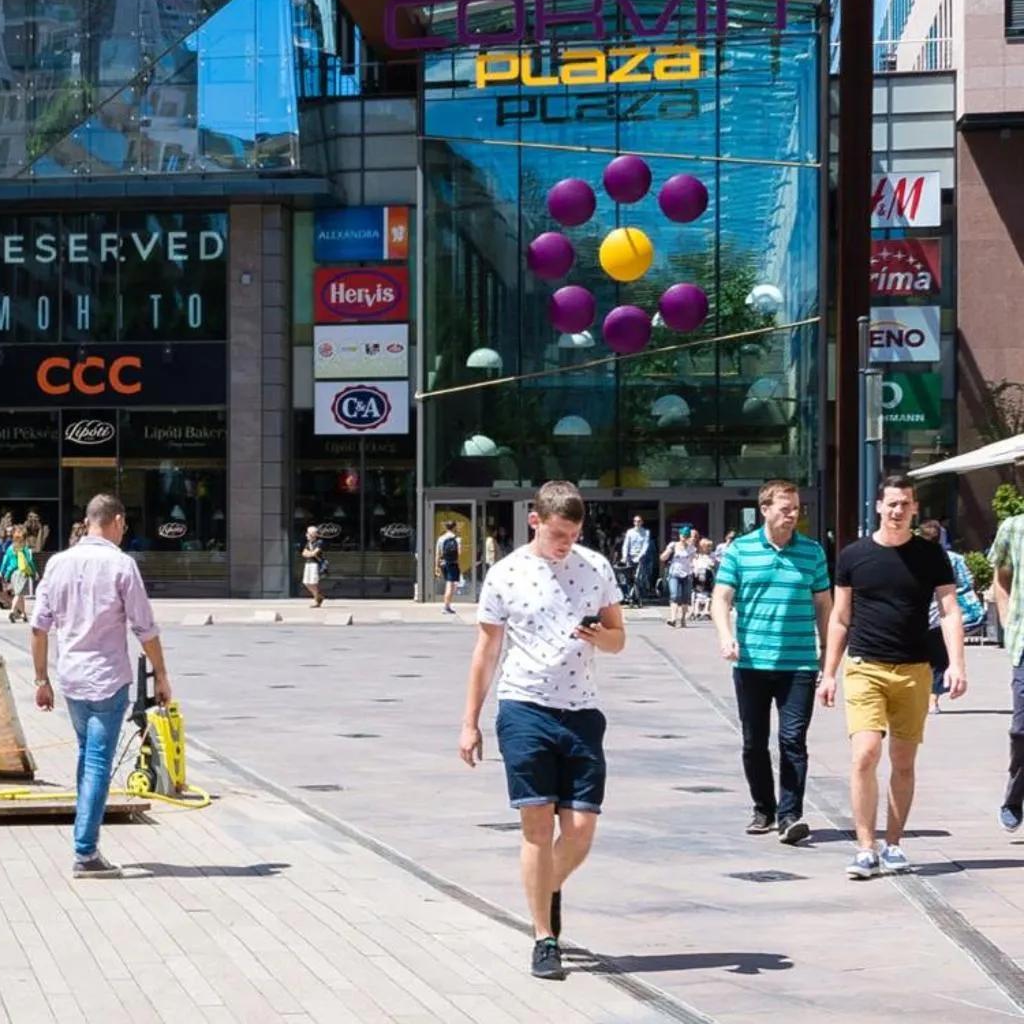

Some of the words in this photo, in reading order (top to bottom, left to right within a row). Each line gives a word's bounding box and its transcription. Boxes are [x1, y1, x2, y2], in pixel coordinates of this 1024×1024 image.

[329, 283, 396, 308] Hervis
[869, 328, 926, 348] ENO
[36, 356, 143, 395] CCC
[342, 396, 381, 419] C&A
